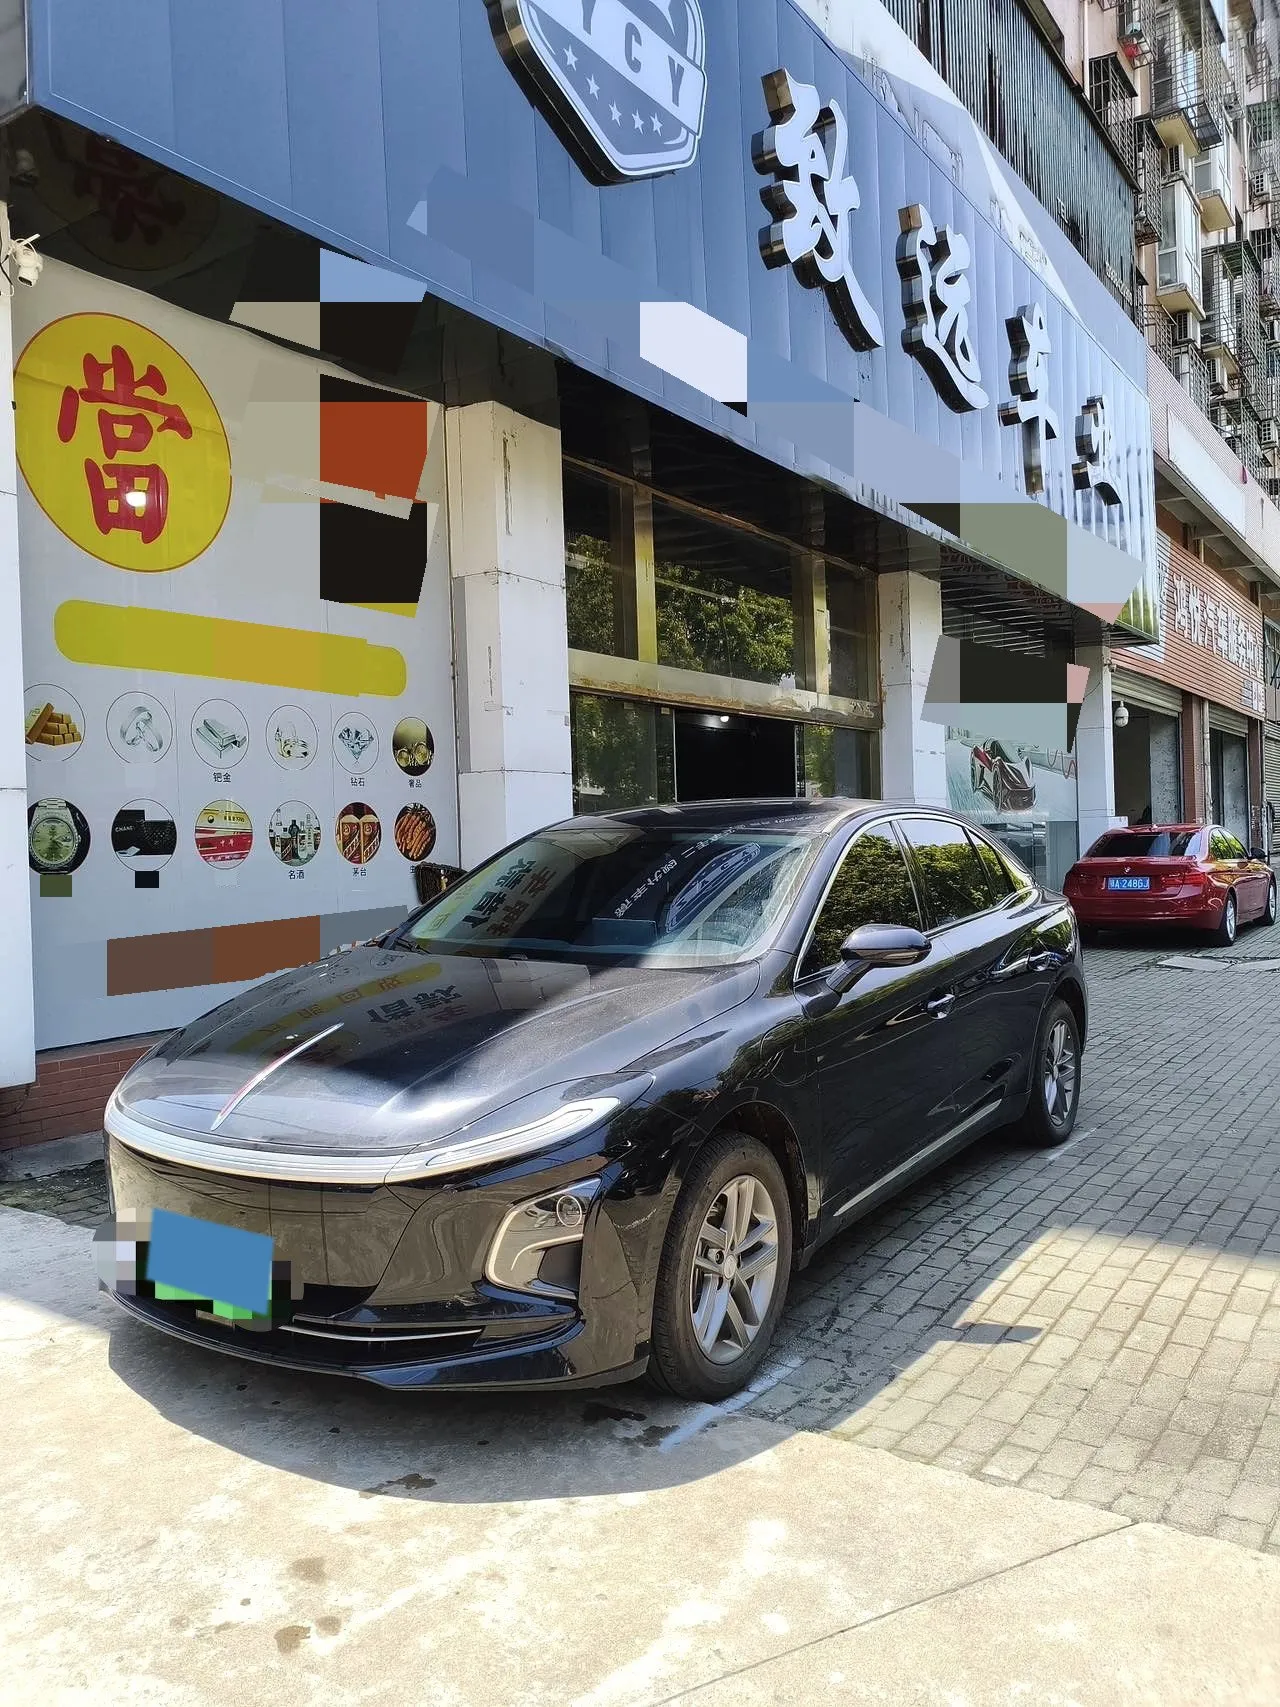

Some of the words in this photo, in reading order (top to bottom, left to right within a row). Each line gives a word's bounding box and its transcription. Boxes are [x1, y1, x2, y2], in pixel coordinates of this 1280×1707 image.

[57, 344, 193, 545] 當
[212, 771, 232, 783] 钯金
[350, 777, 366, 788] 钻石
[287, 870, 305, 880] 名酒
[351, 867, 368, 877] 茅台
